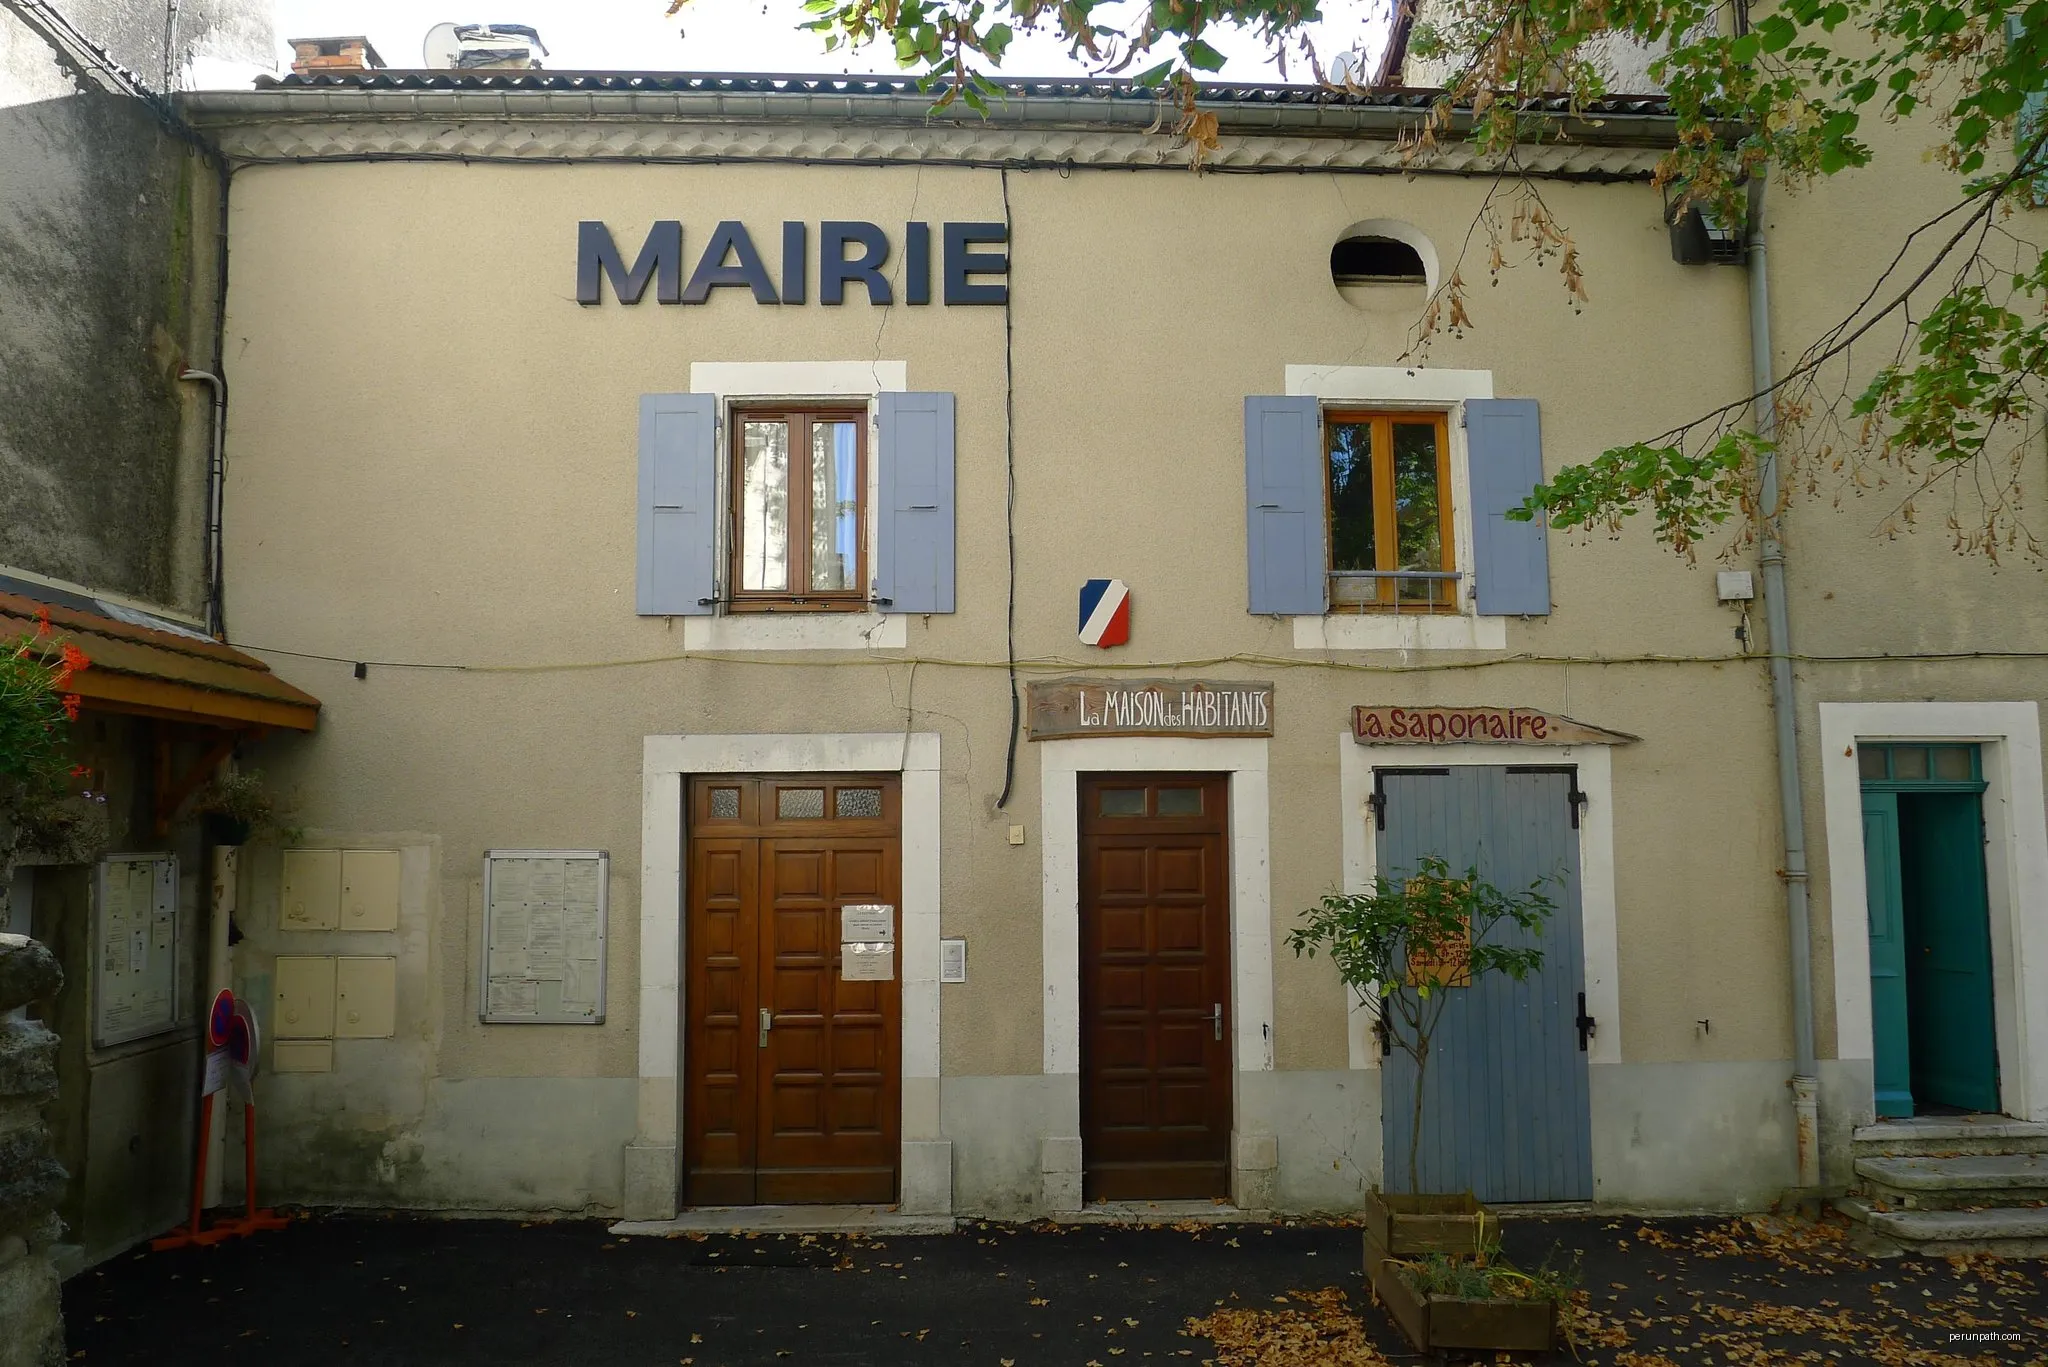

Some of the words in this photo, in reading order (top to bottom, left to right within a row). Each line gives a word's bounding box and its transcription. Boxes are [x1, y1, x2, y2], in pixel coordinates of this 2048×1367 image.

[576, 220, 1006, 306] MAIRIE
[1080, 691, 1100, 726] La
[1163, 703, 1181, 727] des
[1181, 691, 1268, 727] HABITANTS
[1389, 708, 1548, 742] Saponaire
